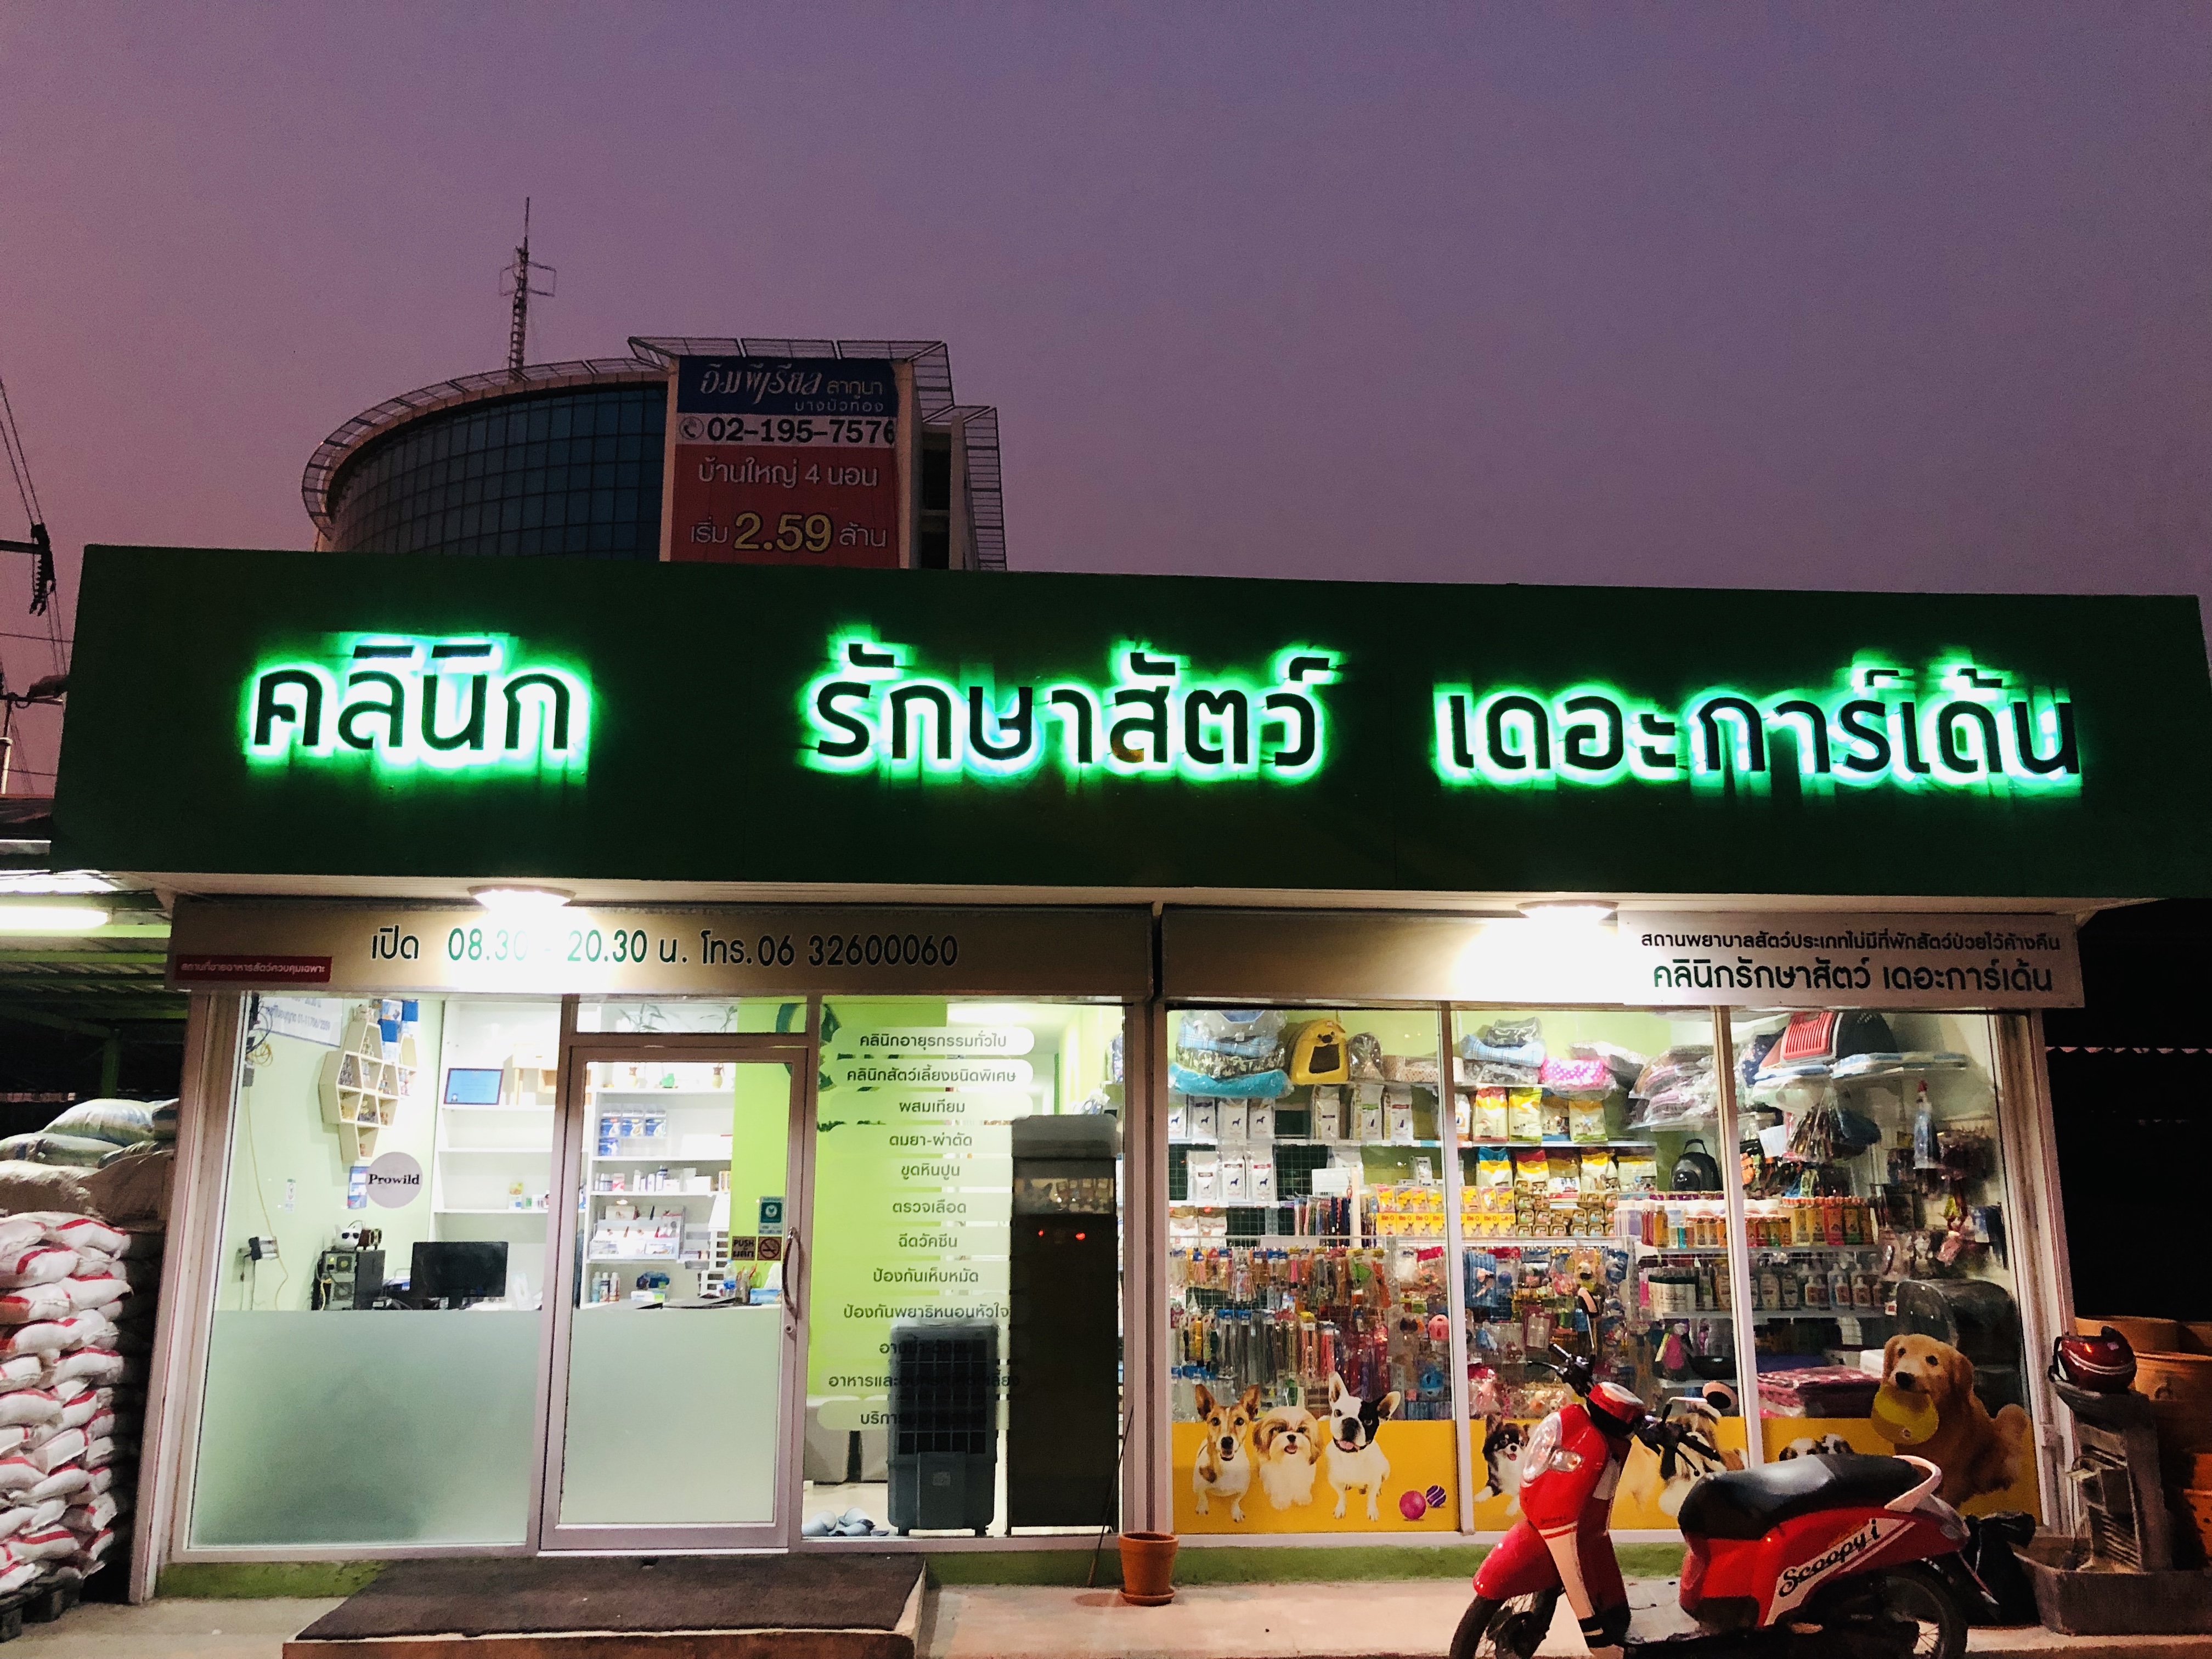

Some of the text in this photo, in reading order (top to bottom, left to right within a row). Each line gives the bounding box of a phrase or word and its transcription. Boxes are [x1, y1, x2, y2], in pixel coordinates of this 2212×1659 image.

[826, 380, 884, 399] ลากูนา
[794, 398, 884, 412] บางบัวทอง
[707, 416, 895, 445] 02-195-7576
[698, 456, 878, 489] บ้านใหญ่ 4 นอน
[691, 511, 886, 552] เริ่ม 2.59 ล้าน
[254, 642, 2080, 775] คลินิก รักษาสัตว์ เดอะการ์เด้น
[371, 925, 420, 960] เปิด
[448, 928, 528, 961] 08.30
[567, 929, 647, 963] 20.30
[659, 939, 688, 964] น.
[808, 934, 958, 967] 32600060
[1654, 956, 2052, 991] คลินิกรักษาสัตว์ เดอะการ์เด้น
[860, 1030, 1007, 1051] คลินิกอายุรกรรมทั่วไป
[847, 1064, 1017, 1082] คลินิกสัตว์เลี้ยงชนิดพิเศษ
[899, 1098, 966, 1113] ผสมเทียม
[889, 1132, 973, 1147] ดมยา-ผ่าตัด
[368, 1173, 420, 1185] Prowild
[901, 1163, 961, 1181] ขูดหินปูน
[893, 1199, 967, 1214] ตรวจเลือด
[899, 1233, 957, 1248] ฉีดวัคซีน
[873, 1267, 979, 1283] ป้องกันเห็บหมัด
[843, 1302, 1009, 1319] ป้องกันพยาธิหนอนหัวใจ
